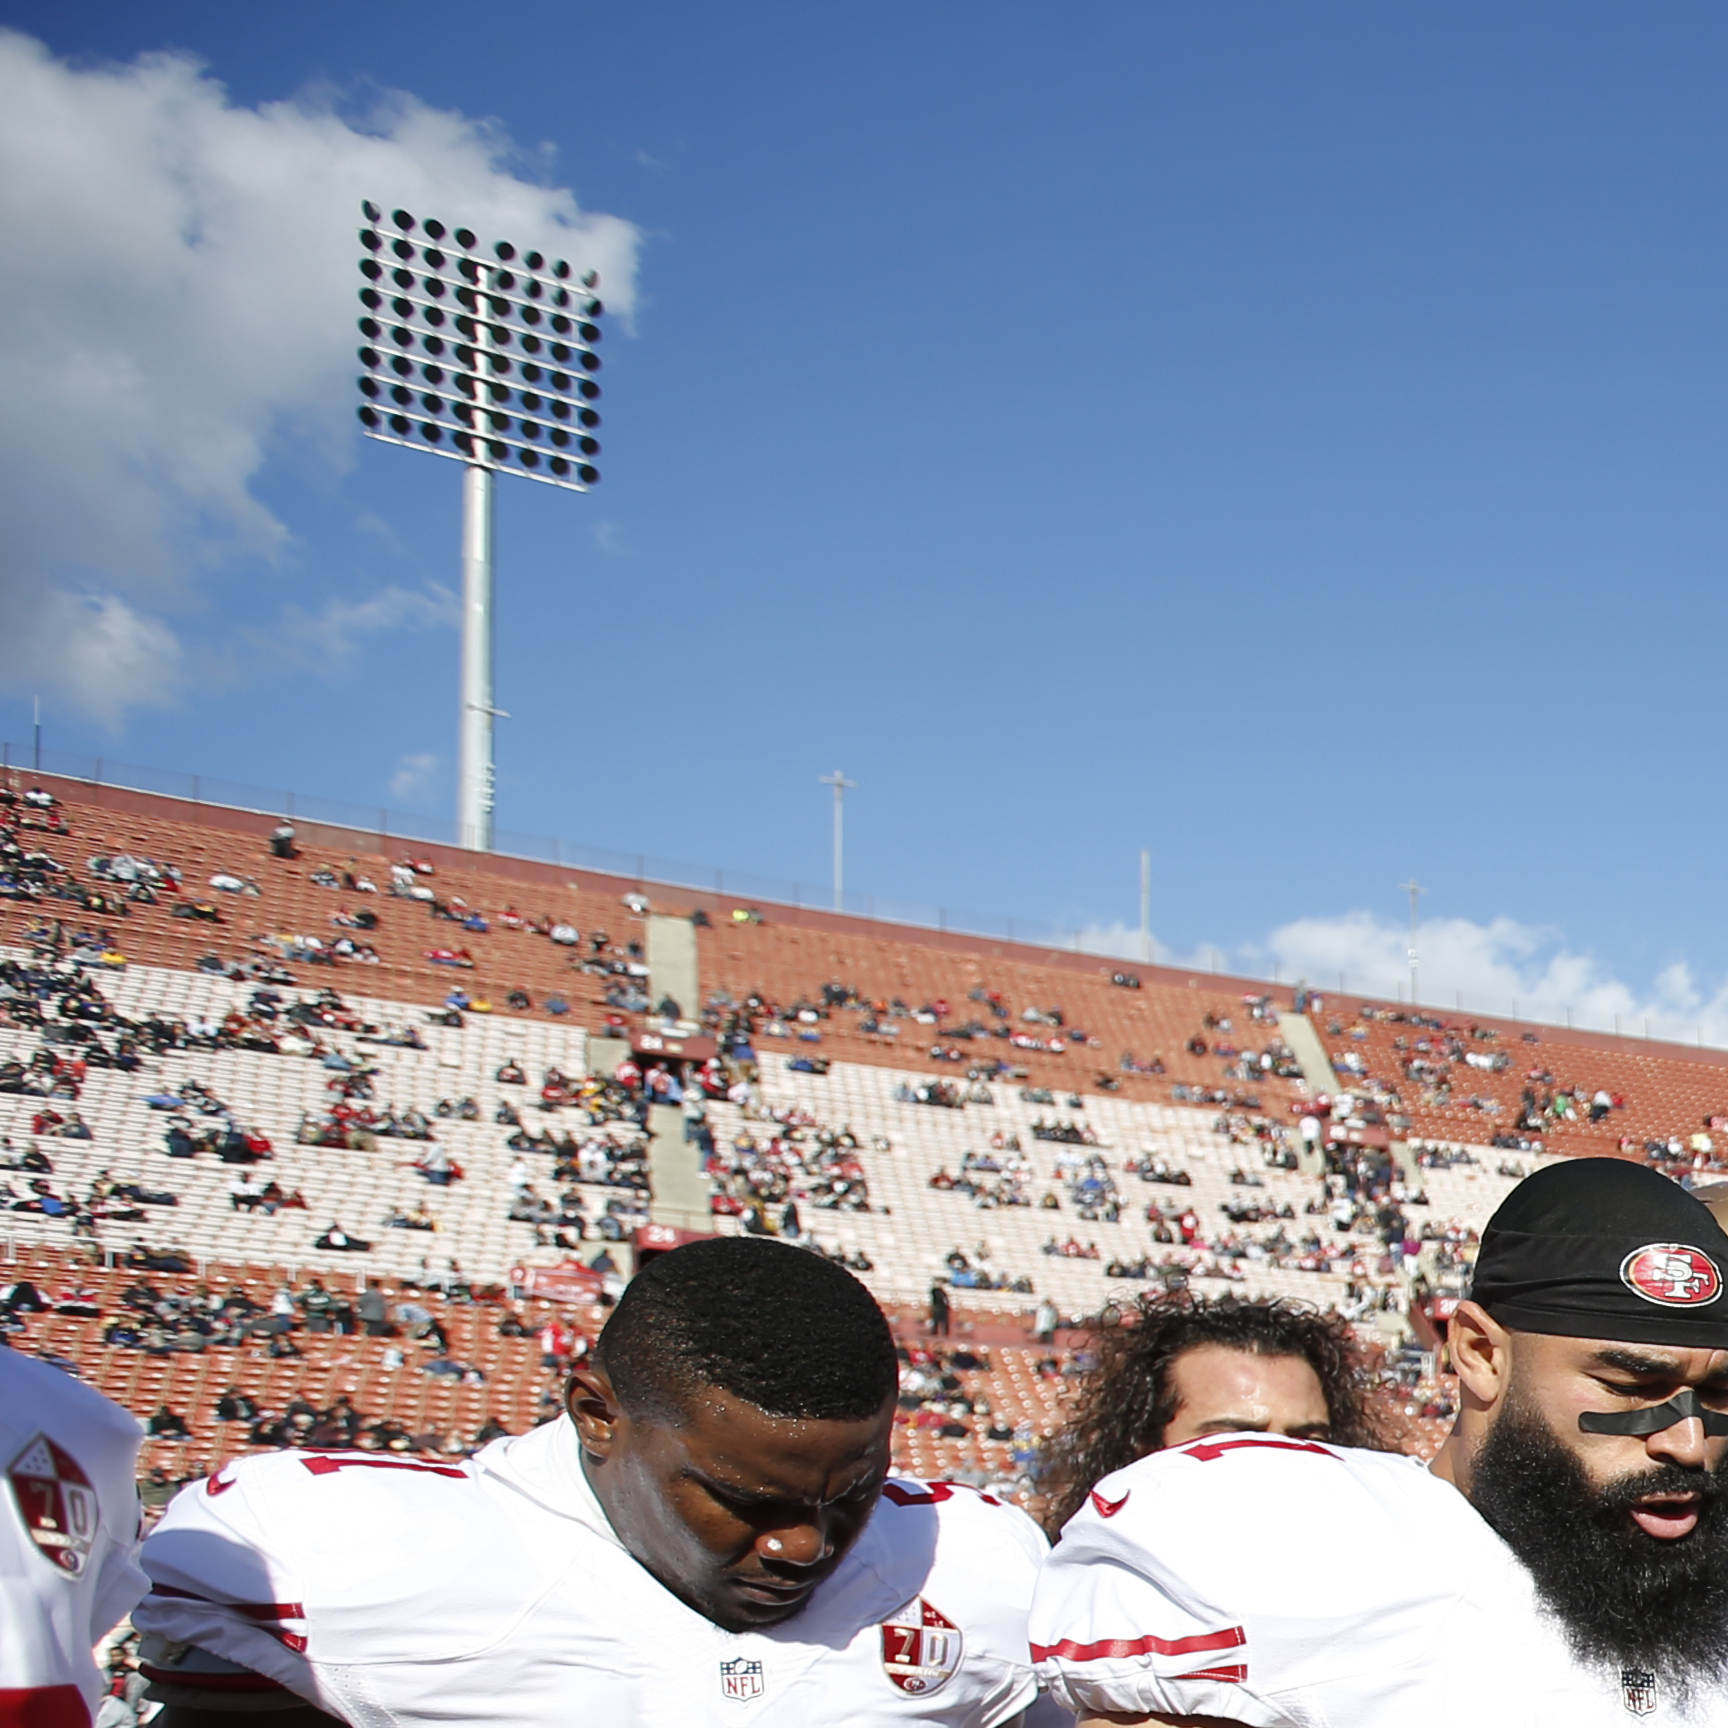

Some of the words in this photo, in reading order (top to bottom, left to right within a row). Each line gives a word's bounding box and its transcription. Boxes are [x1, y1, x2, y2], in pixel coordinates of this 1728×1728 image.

[894, 1628, 948, 1667] 70
[726, 1676, 761, 1697] NFL
[1627, 1687, 1654, 1711] NFL
